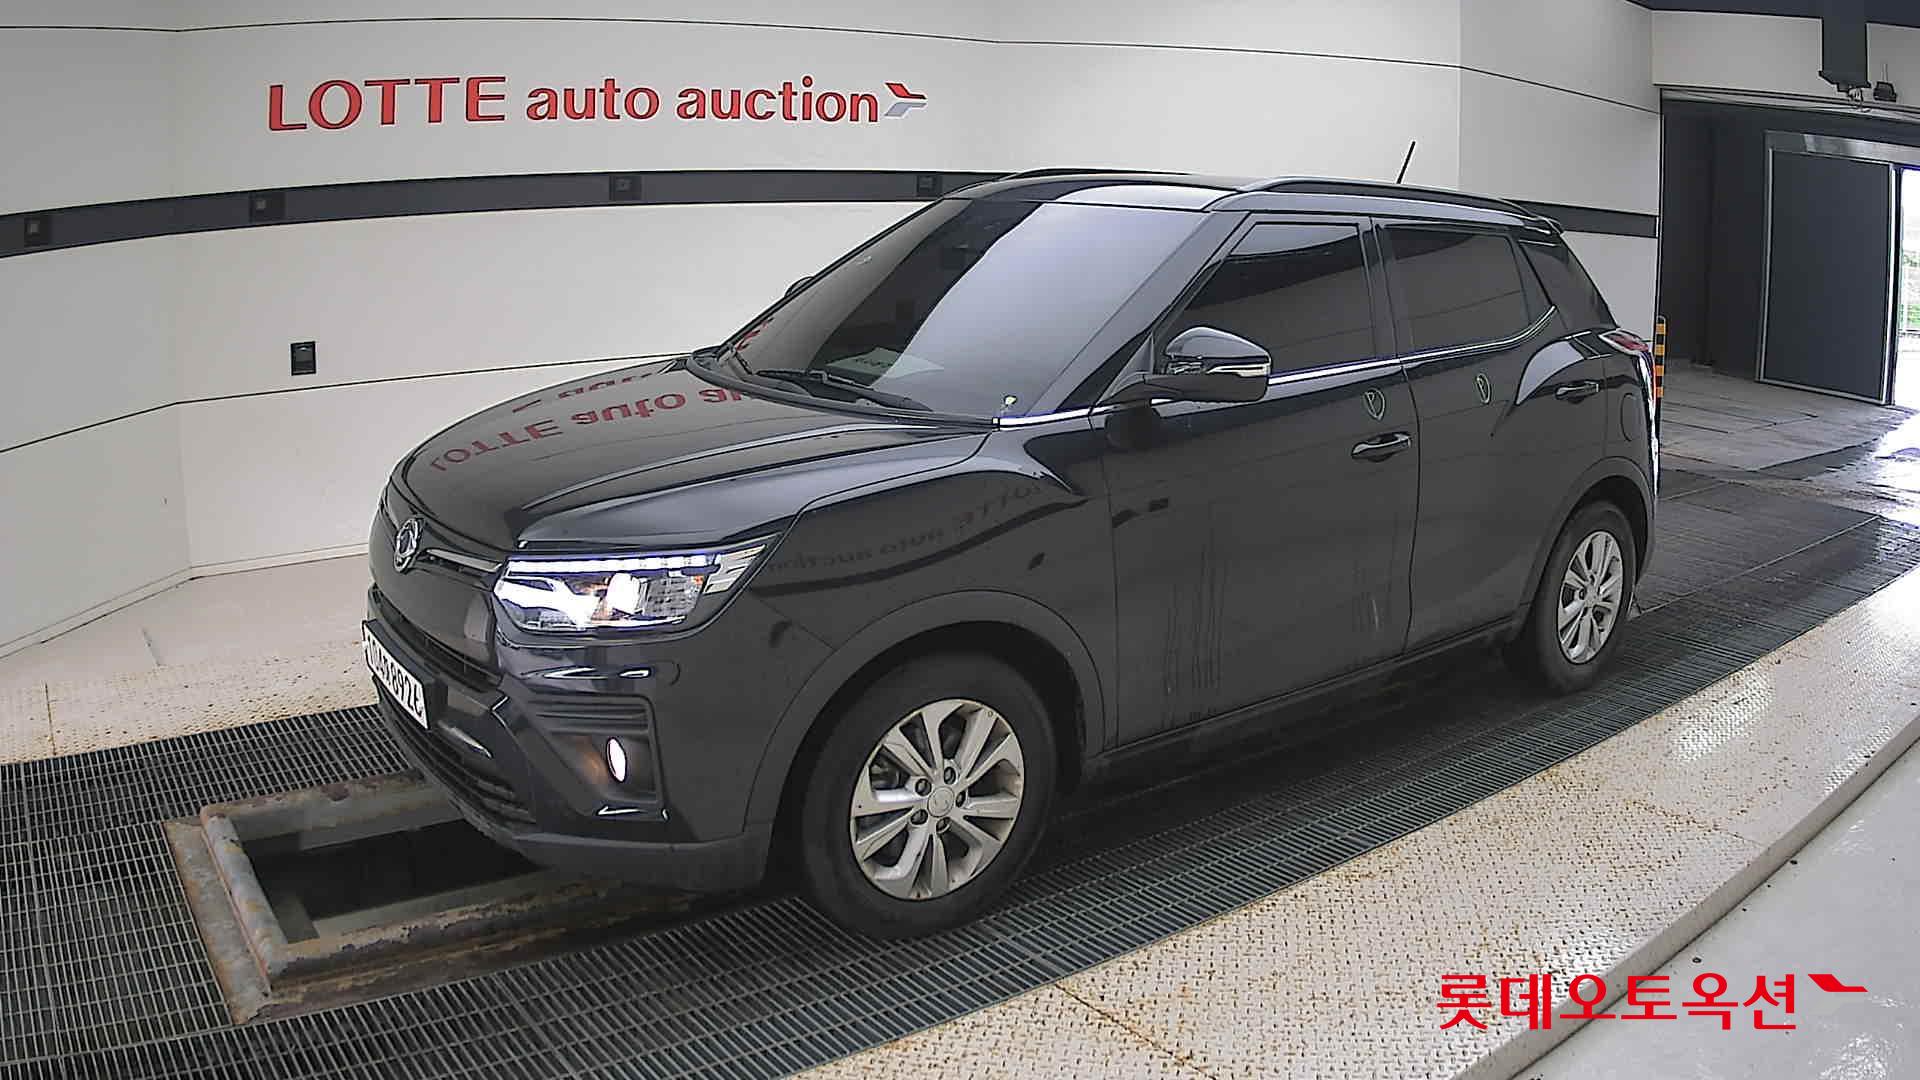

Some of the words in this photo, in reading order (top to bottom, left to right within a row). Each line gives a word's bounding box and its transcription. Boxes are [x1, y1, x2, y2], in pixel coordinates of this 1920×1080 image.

[267, 76, 506, 132] LOTTE
[526, 78, 661, 122] auto
[675, 75, 879, 123] auction
